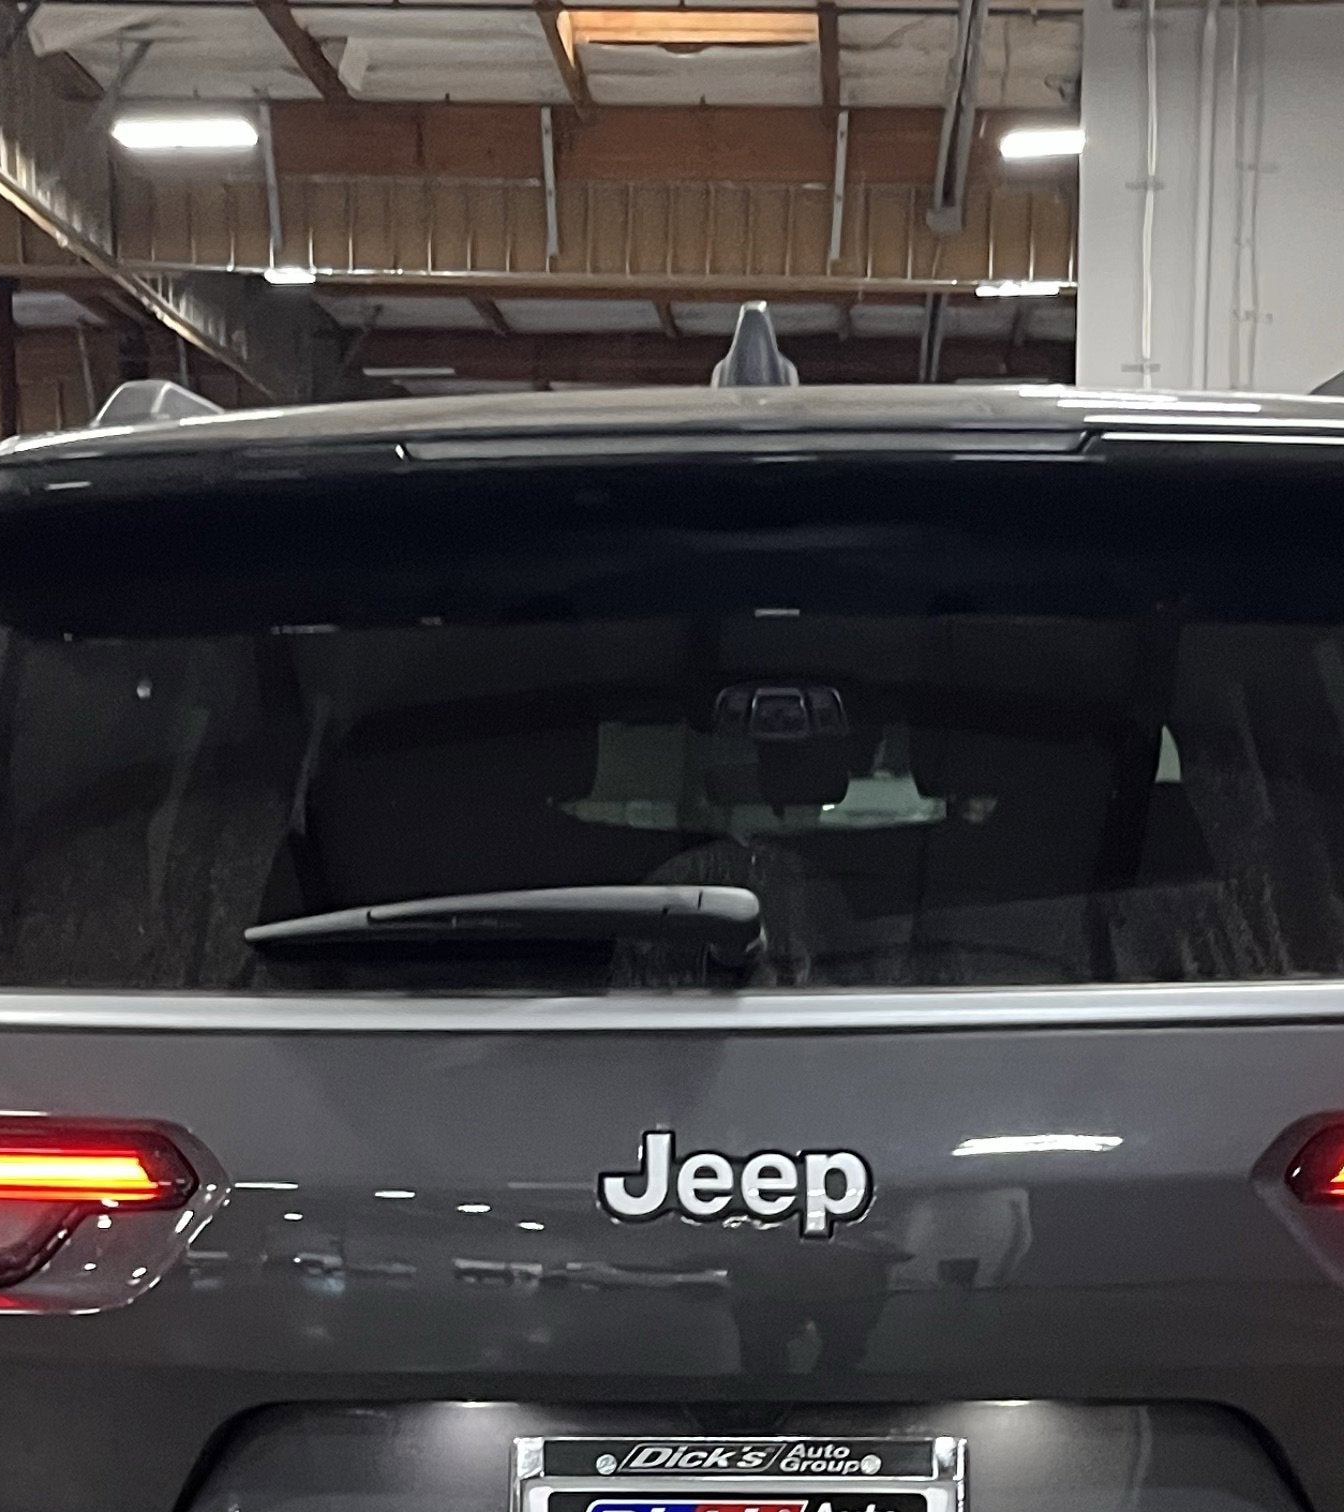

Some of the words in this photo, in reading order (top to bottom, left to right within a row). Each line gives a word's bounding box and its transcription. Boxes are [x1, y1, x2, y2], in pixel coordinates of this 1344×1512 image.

[599, 1130, 873, 1238] Jeep
[629, 1446, 767, 1469] Dick's
[787, 1444, 850, 1458] Auto
[780, 1458, 861, 1475] Group
